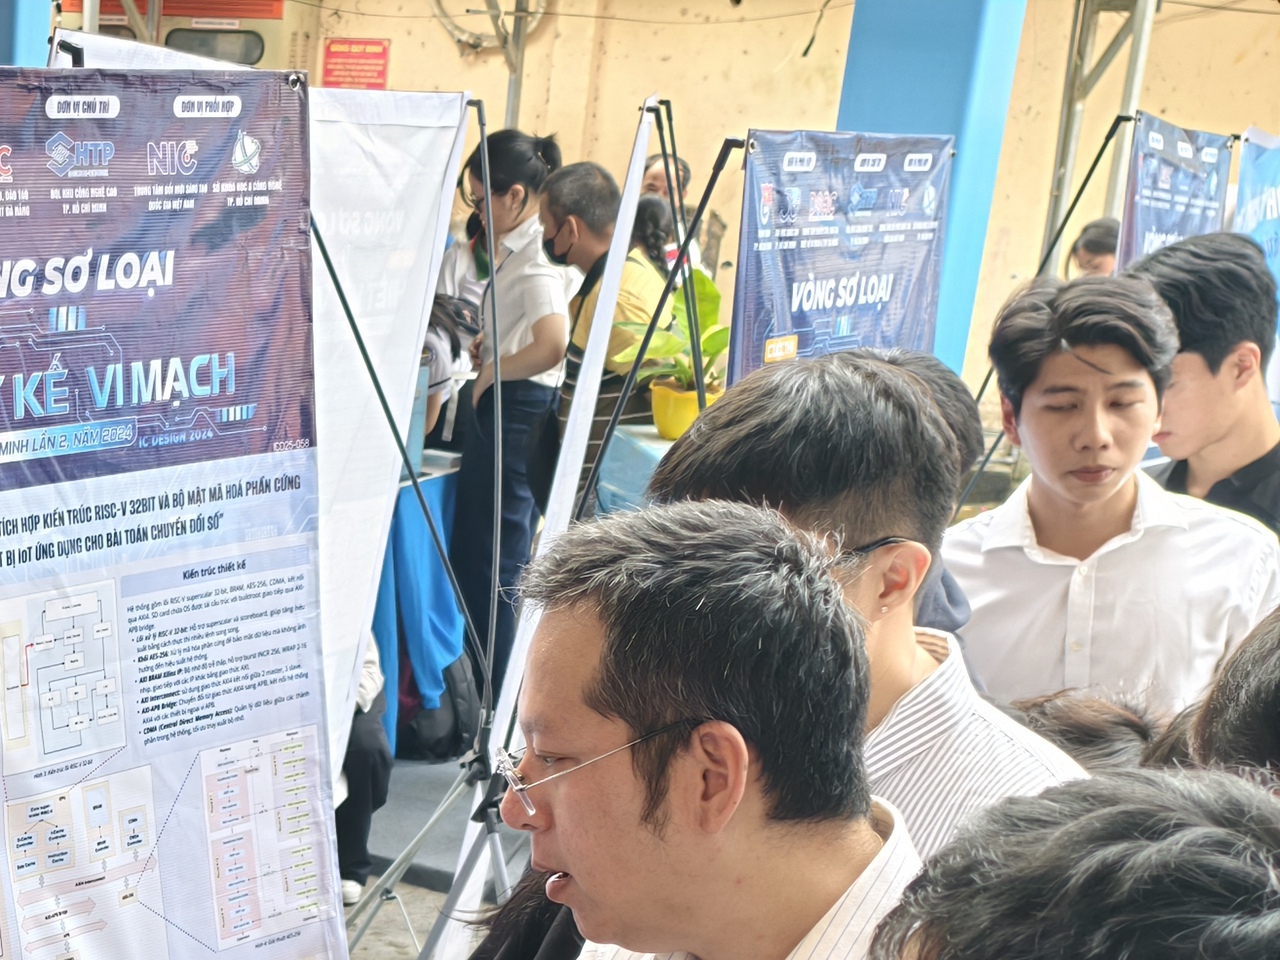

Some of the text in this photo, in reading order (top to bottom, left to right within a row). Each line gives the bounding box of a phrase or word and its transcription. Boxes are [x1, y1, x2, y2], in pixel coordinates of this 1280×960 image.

[41, 247, 94, 294] SƠ
[96, 250, 175, 298] LOẠI
[791, 271, 894, 312] VÒNG SƠ LOẠI
[13, 352, 70, 421] KẾ
[85, 362, 123, 411] VI
[130, 351, 237, 409] MẠCH
[0, 438, 29, 458] MINH
[32, 426, 57, 455] LẦN
[59, 434, 70, 454] 2,
[71, 427, 100, 452] NĂM
[102, 424, 133, 444] 2024
[138, 428, 214, 448] IC DESIGN 2024
[21, 513, 41, 536] HỢP
[42, 507, 65, 530] KIẾN
[67, 504, 93, 526] TRÚC
[94, 499, 128, 521] RISC-V
[129, 496, 156, 516] 32BIT
[158, 491, 171, 511] VÀ
[172, 488, 185, 510] BỘ
[187, 485, 206, 507] MẬT
[208, 485, 224, 503] MÃ
[225, 482, 244, 500] HOÁ
[245, 476, 272, 497] PHẦN
[274, 474, 301, 492] CỨNG
[6, 551, 16, 570] BỊ
[18, 547, 32, 565] IoT
[34, 542, 56, 561] ỨNG
[57, 536, 83, 559] DỤNG
[84, 532, 104, 551] CHO
[106, 529, 122, 548] BÀI
[124, 523, 149, 545] TOÁN
[150, 515, 187, 541] CHUYỂN
[189, 512, 205, 533] ĐỔI
[183, 559, 246, 580] Kiến trúc thiết kế
